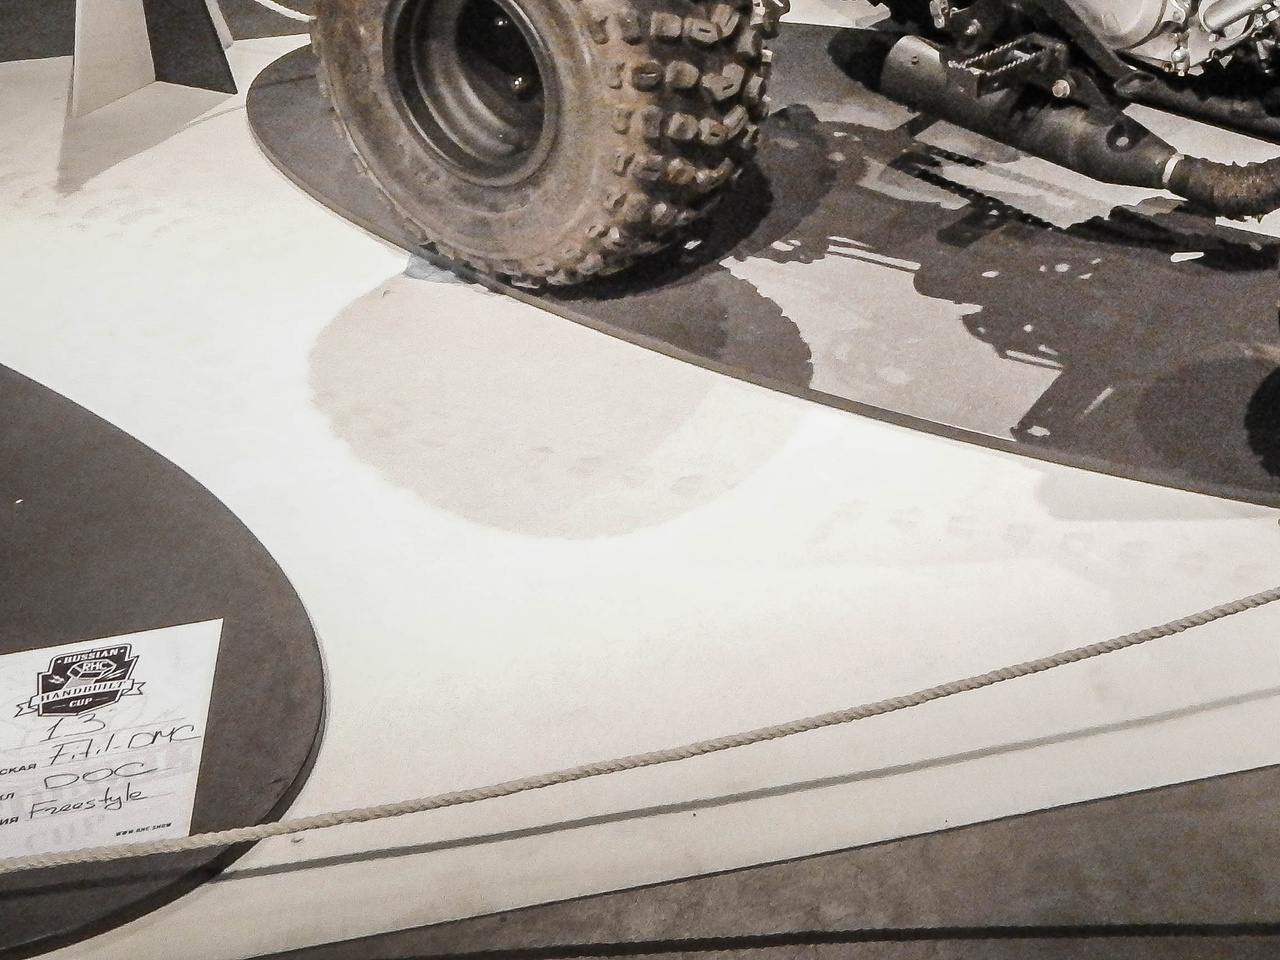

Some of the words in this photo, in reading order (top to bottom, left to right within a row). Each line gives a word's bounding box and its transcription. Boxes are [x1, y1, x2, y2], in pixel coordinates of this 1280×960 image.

[63, 648, 119, 664] RUSSIAN
[82, 660, 108, 673] RHC
[41, 680, 127, 702] HANDBUILT
[69, 697, 93, 708] CUP
